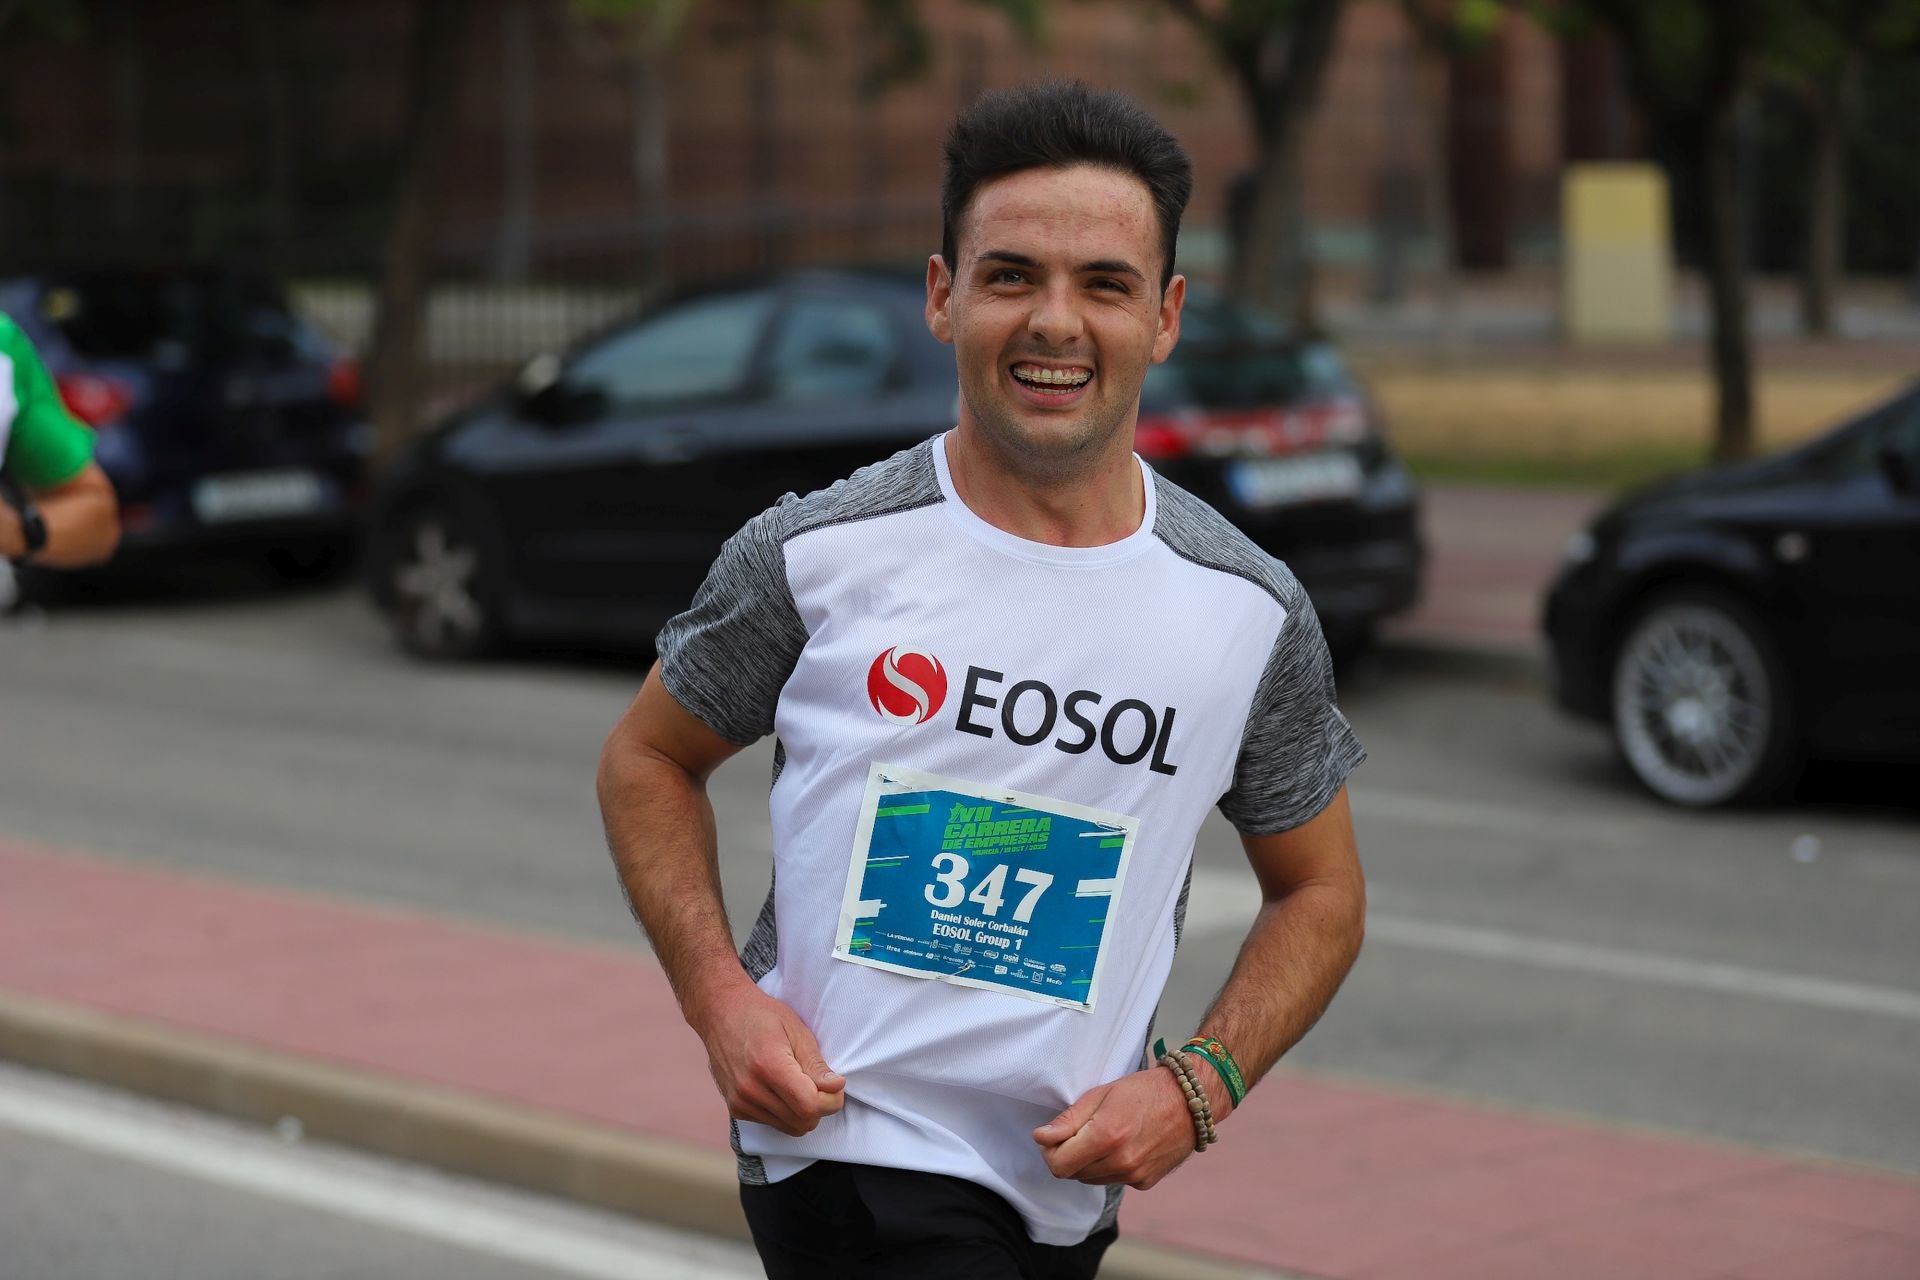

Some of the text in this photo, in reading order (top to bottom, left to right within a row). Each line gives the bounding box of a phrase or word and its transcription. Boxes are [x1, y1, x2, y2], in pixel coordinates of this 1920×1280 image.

[955, 665, 1177, 776] EOSOL
[942, 832, 1050, 850] DE EMPRESAS
[943, 816, 1052, 839] CARRERA
[924, 852, 1055, 924] 347
[930, 909, 1029, 937] Daniel Soler Corbalán
[932, 923, 1023, 951] EOSOL Group 1
